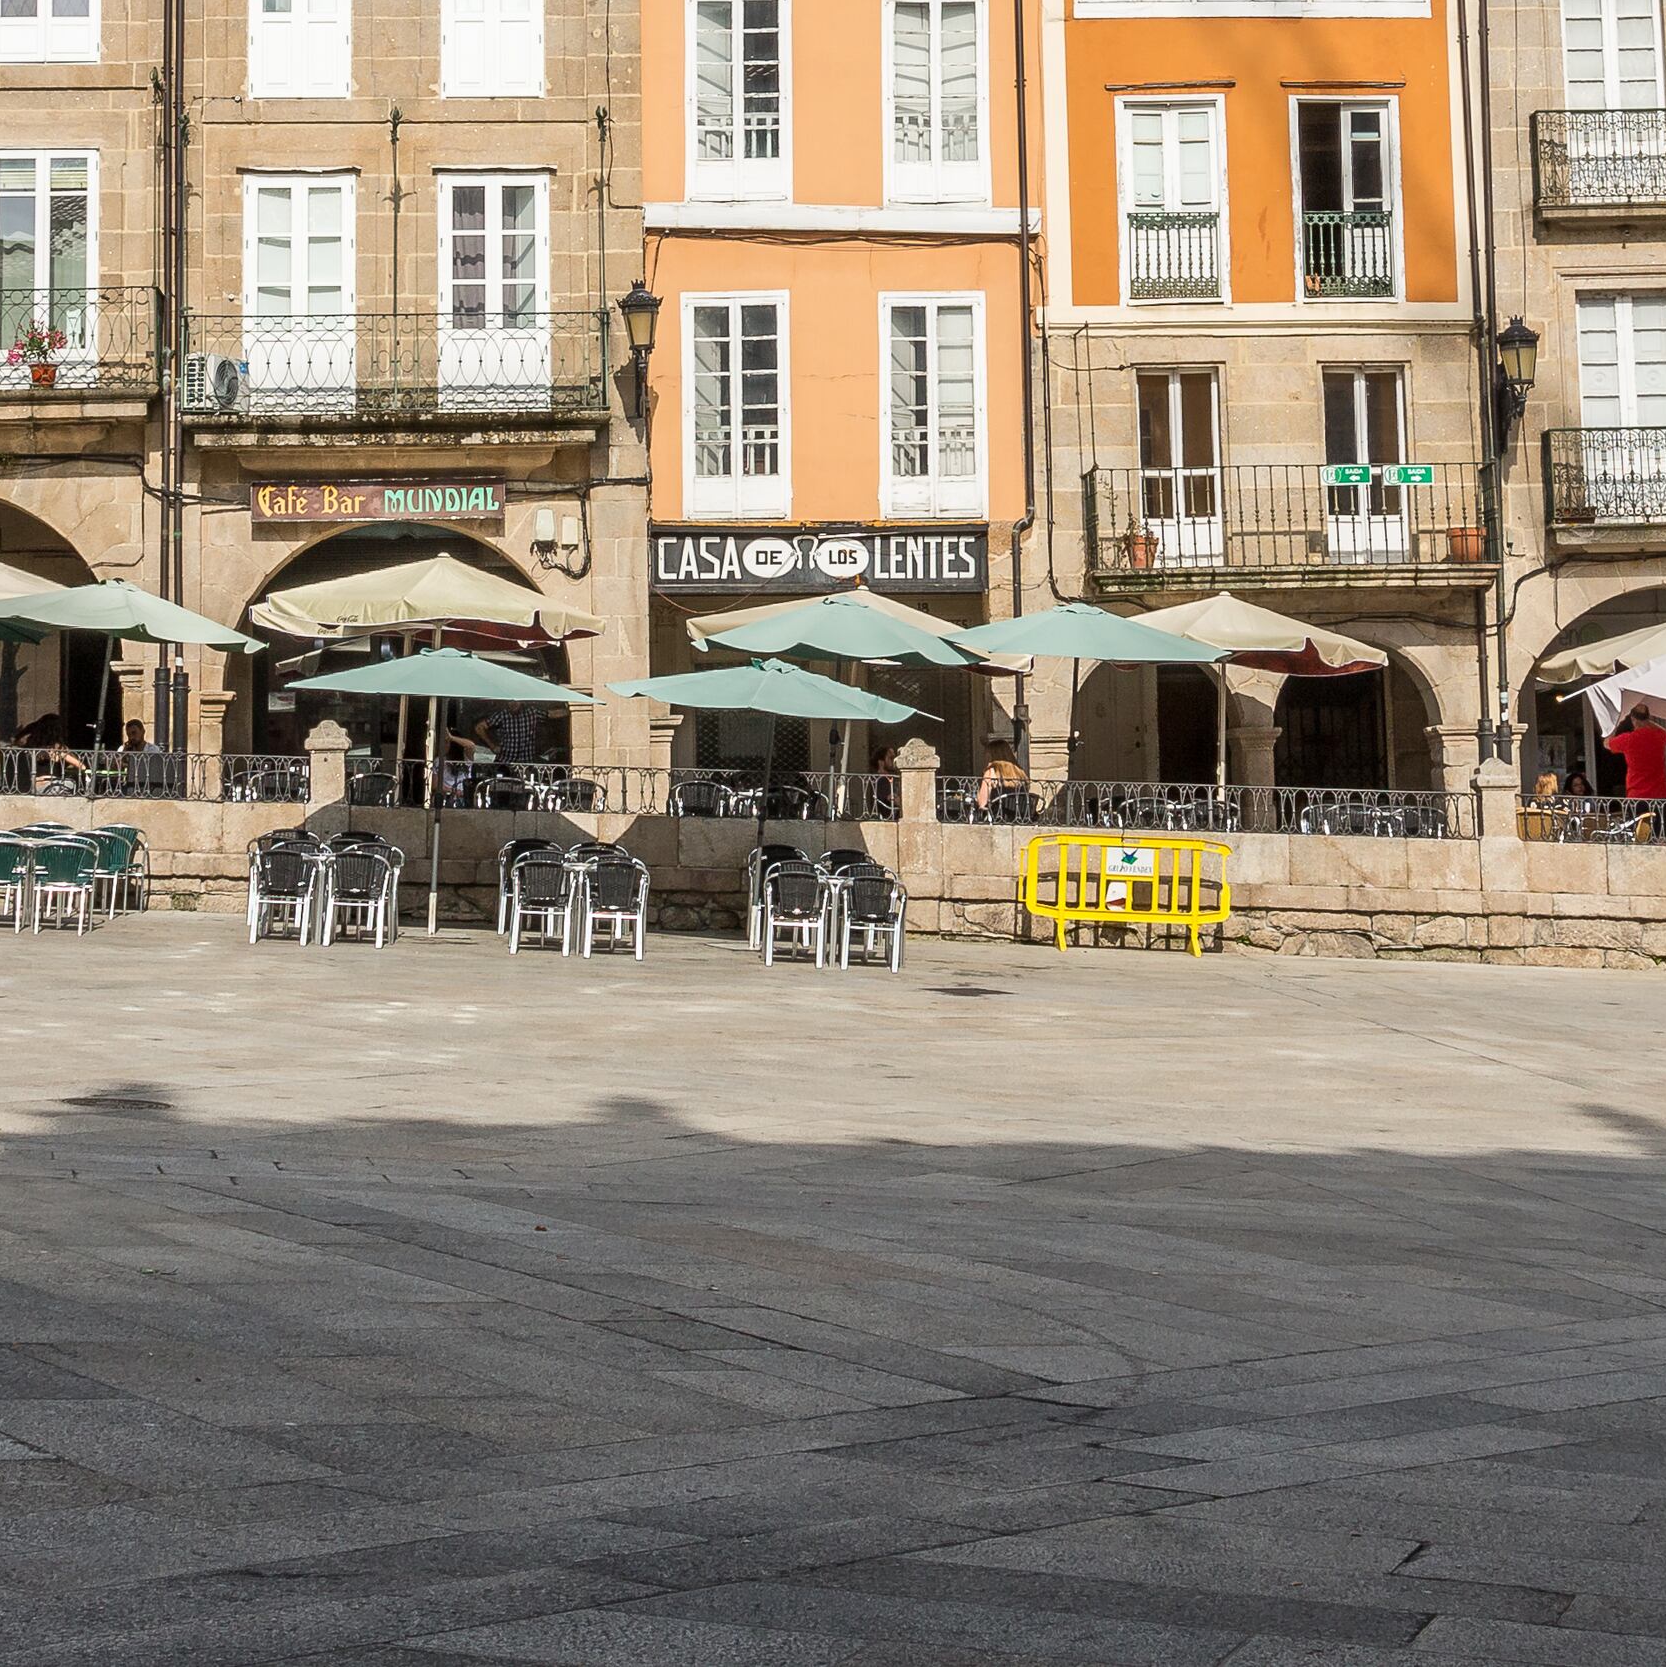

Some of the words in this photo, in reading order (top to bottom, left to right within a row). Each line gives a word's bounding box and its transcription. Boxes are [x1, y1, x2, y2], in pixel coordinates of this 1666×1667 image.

[257, 485, 309, 518] Café
[320, 485, 366, 515] Bar
[384, 486, 500, 514] MUNDIAL
[658, 536, 742, 580] CASA
[756, 549, 783, 566] DE
[828, 548, 858, 565] LOS
[874, 535, 976, 580] LENTES
